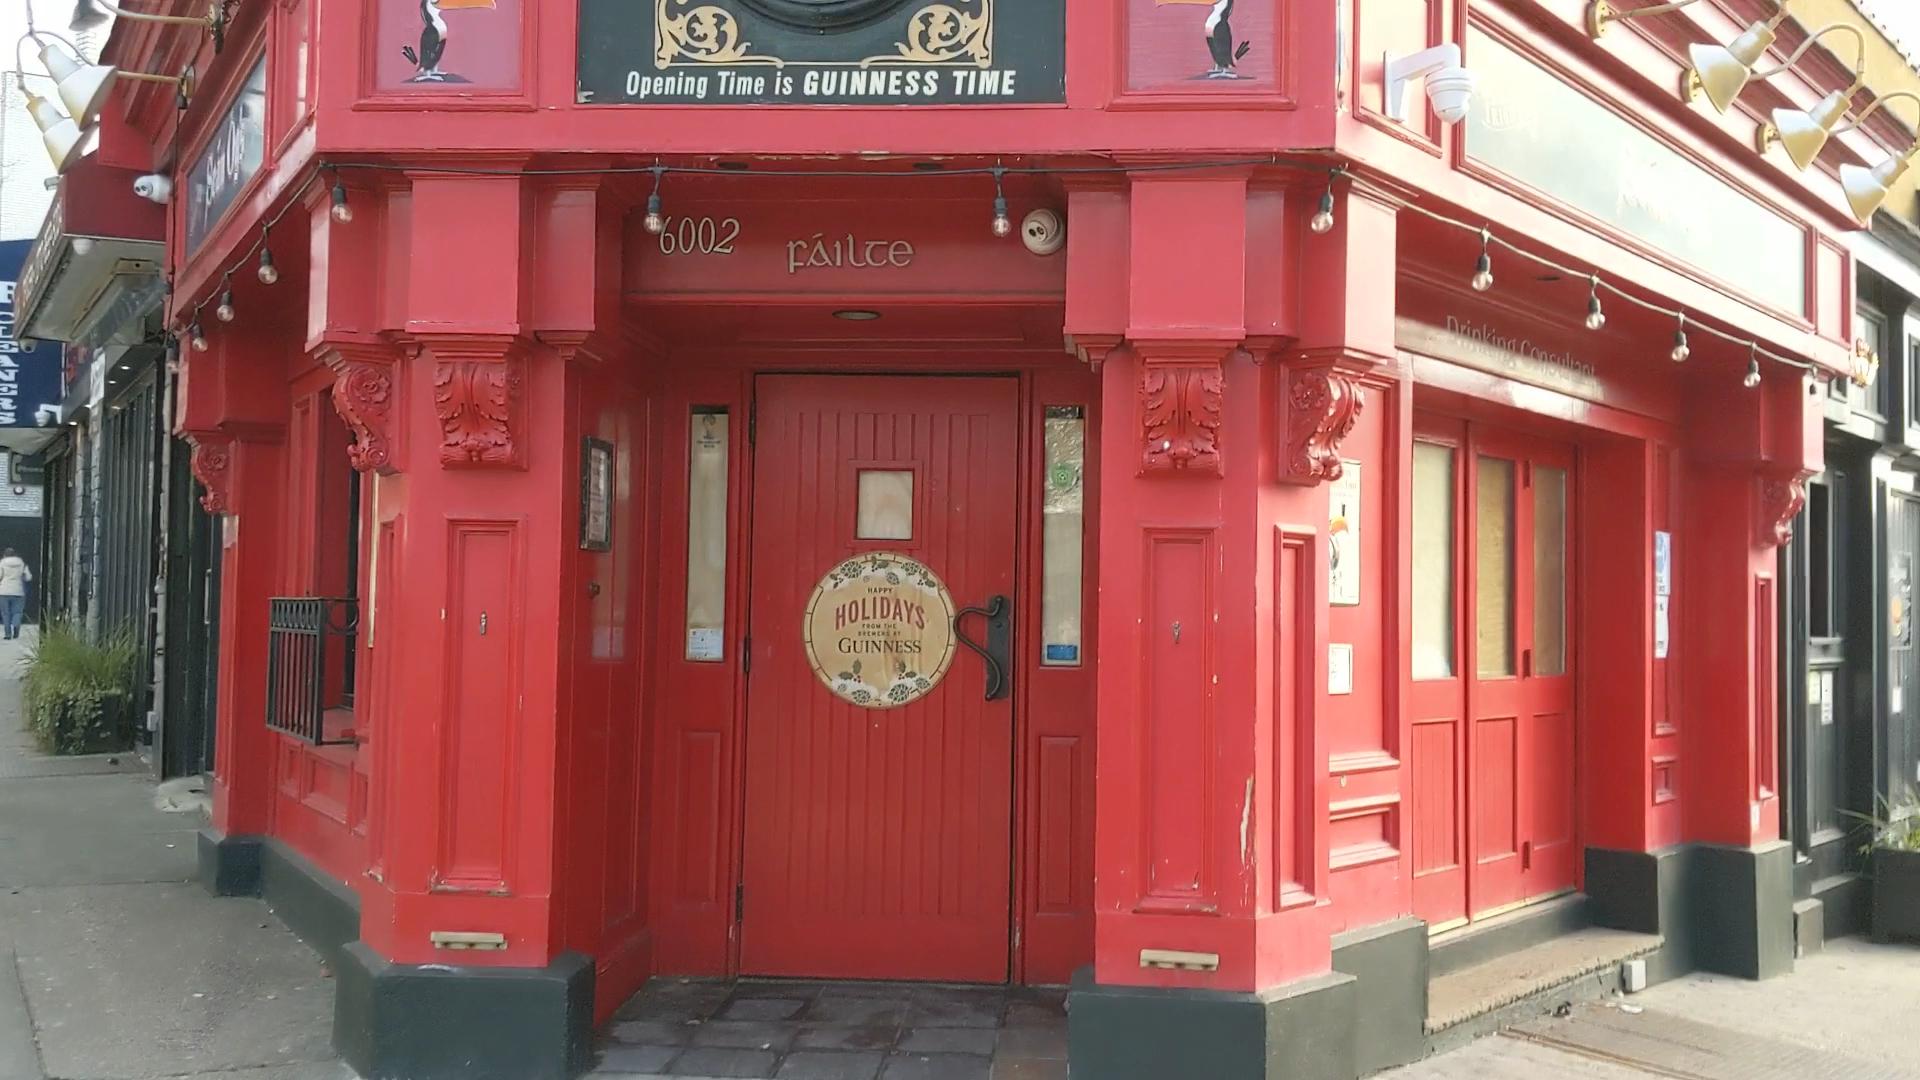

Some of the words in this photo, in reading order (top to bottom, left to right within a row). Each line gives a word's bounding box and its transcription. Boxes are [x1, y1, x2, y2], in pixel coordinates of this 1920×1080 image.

[626, 71, 708, 99] Opening
[717, 71, 765, 96] Time
[774, 71, 794, 96] is
[803, 70, 939, 96] GUINNESS
[953, 70, 1017, 96] TIME
[659, 216, 741, 255] 6002
[1446, 315, 1517, 366] Drinking
[835, 596, 925, 631] HOLIDAYS
[838, 637, 922, 654] GUINNESS
